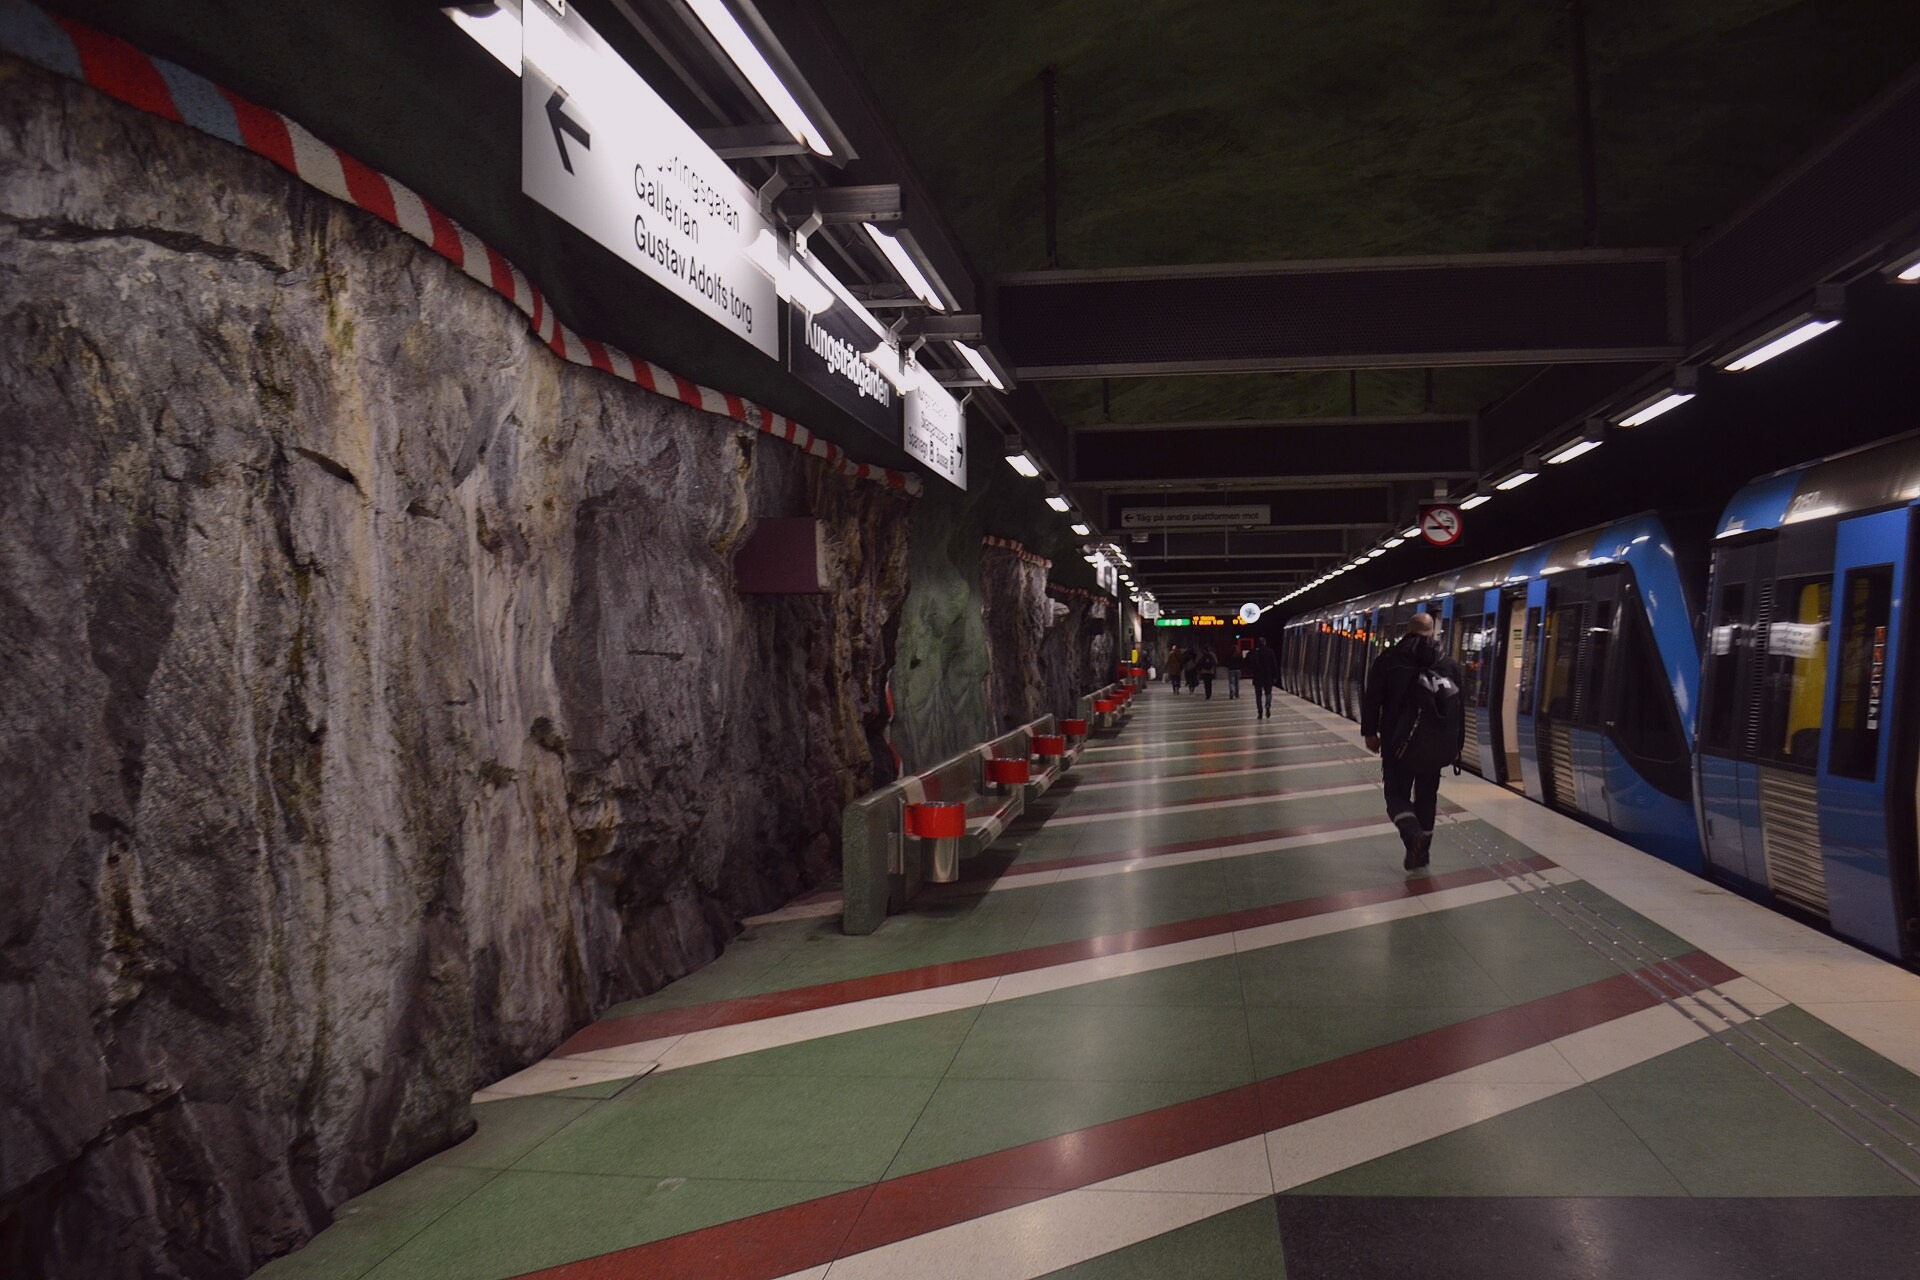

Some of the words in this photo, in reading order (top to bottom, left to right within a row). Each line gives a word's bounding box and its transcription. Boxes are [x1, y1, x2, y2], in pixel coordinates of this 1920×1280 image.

[634, 163, 699, 244] Gallerian
[634, 214, 686, 280] Gustav
[688, 256, 728, 311] Adolfs
[730, 287, 753, 334] torg
[804, 309, 890, 408] Kungsträdgården
[1136, 512, 1151, 523] Tåg
[1153, 512, 1165, 523] på
[1166, 512, 1190, 521] andra
[1192, 511, 1240, 522] plattformen
[1242, 511, 1259, 520] mot
